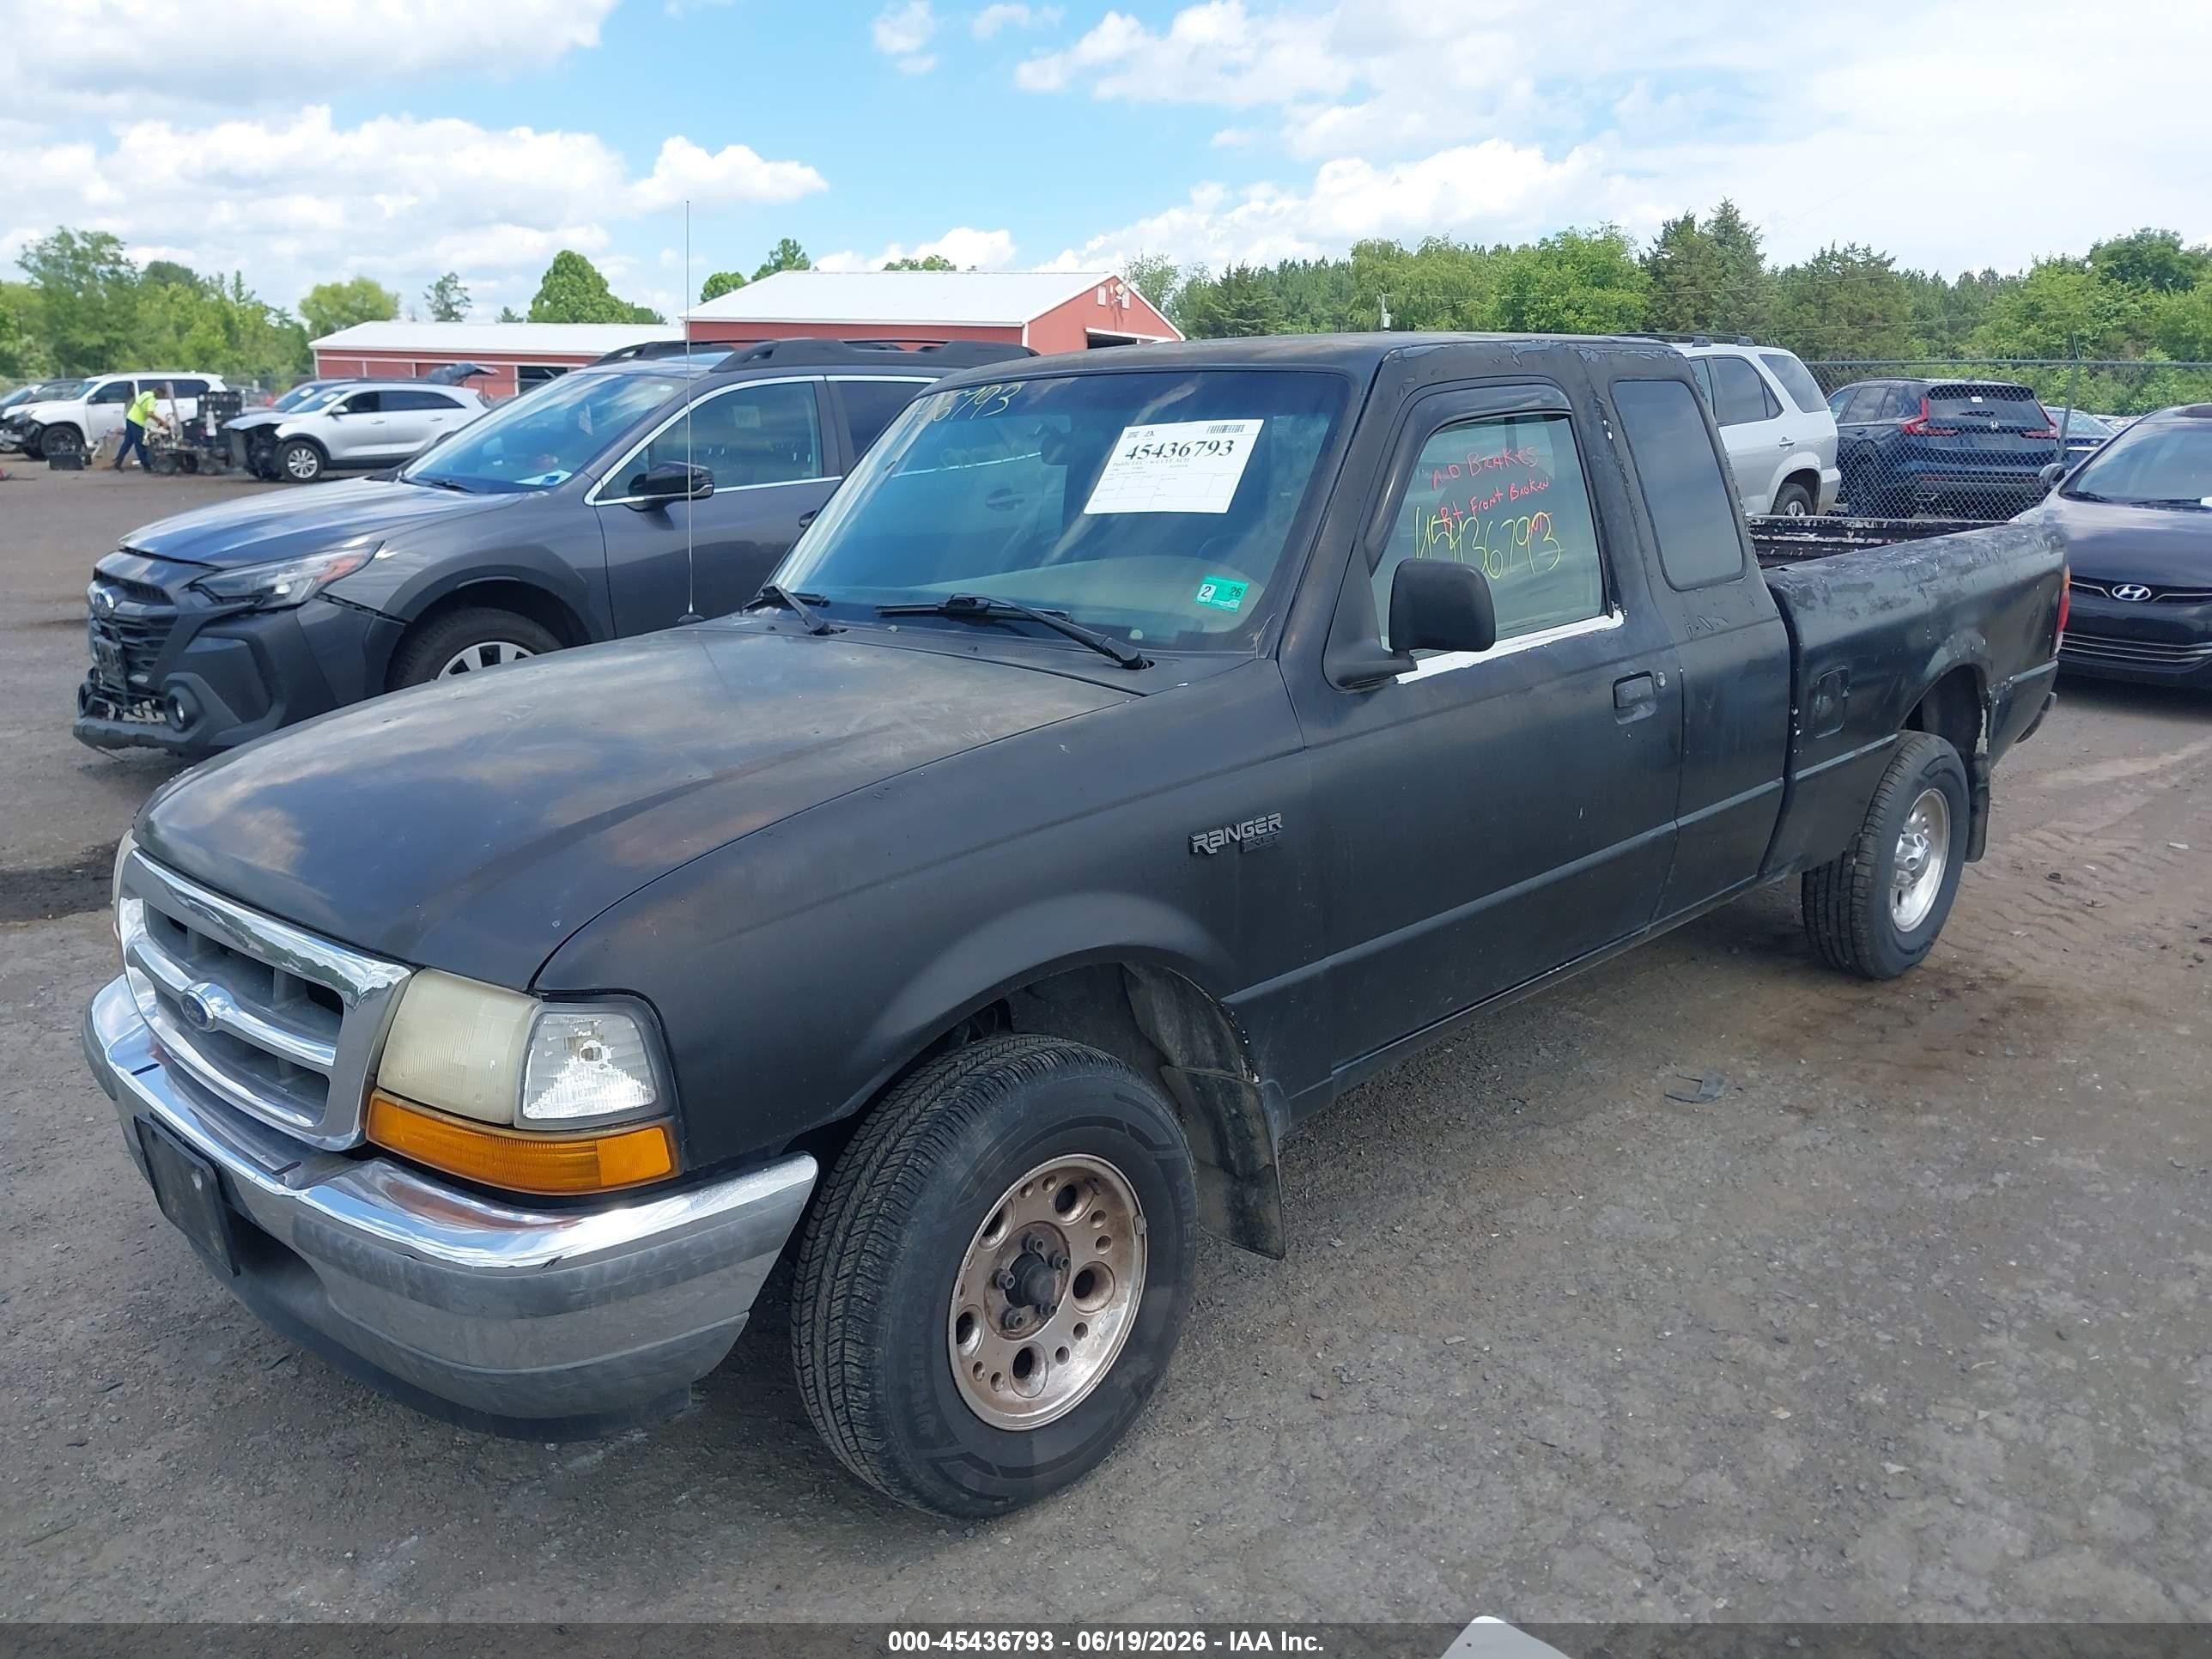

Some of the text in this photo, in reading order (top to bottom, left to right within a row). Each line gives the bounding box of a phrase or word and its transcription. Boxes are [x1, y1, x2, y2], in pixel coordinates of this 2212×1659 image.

[1126, 440, 1234, 459] 45436793
[1200, 586, 1243, 598] 2 26
[1191, 812, 1284, 854] RANGER
